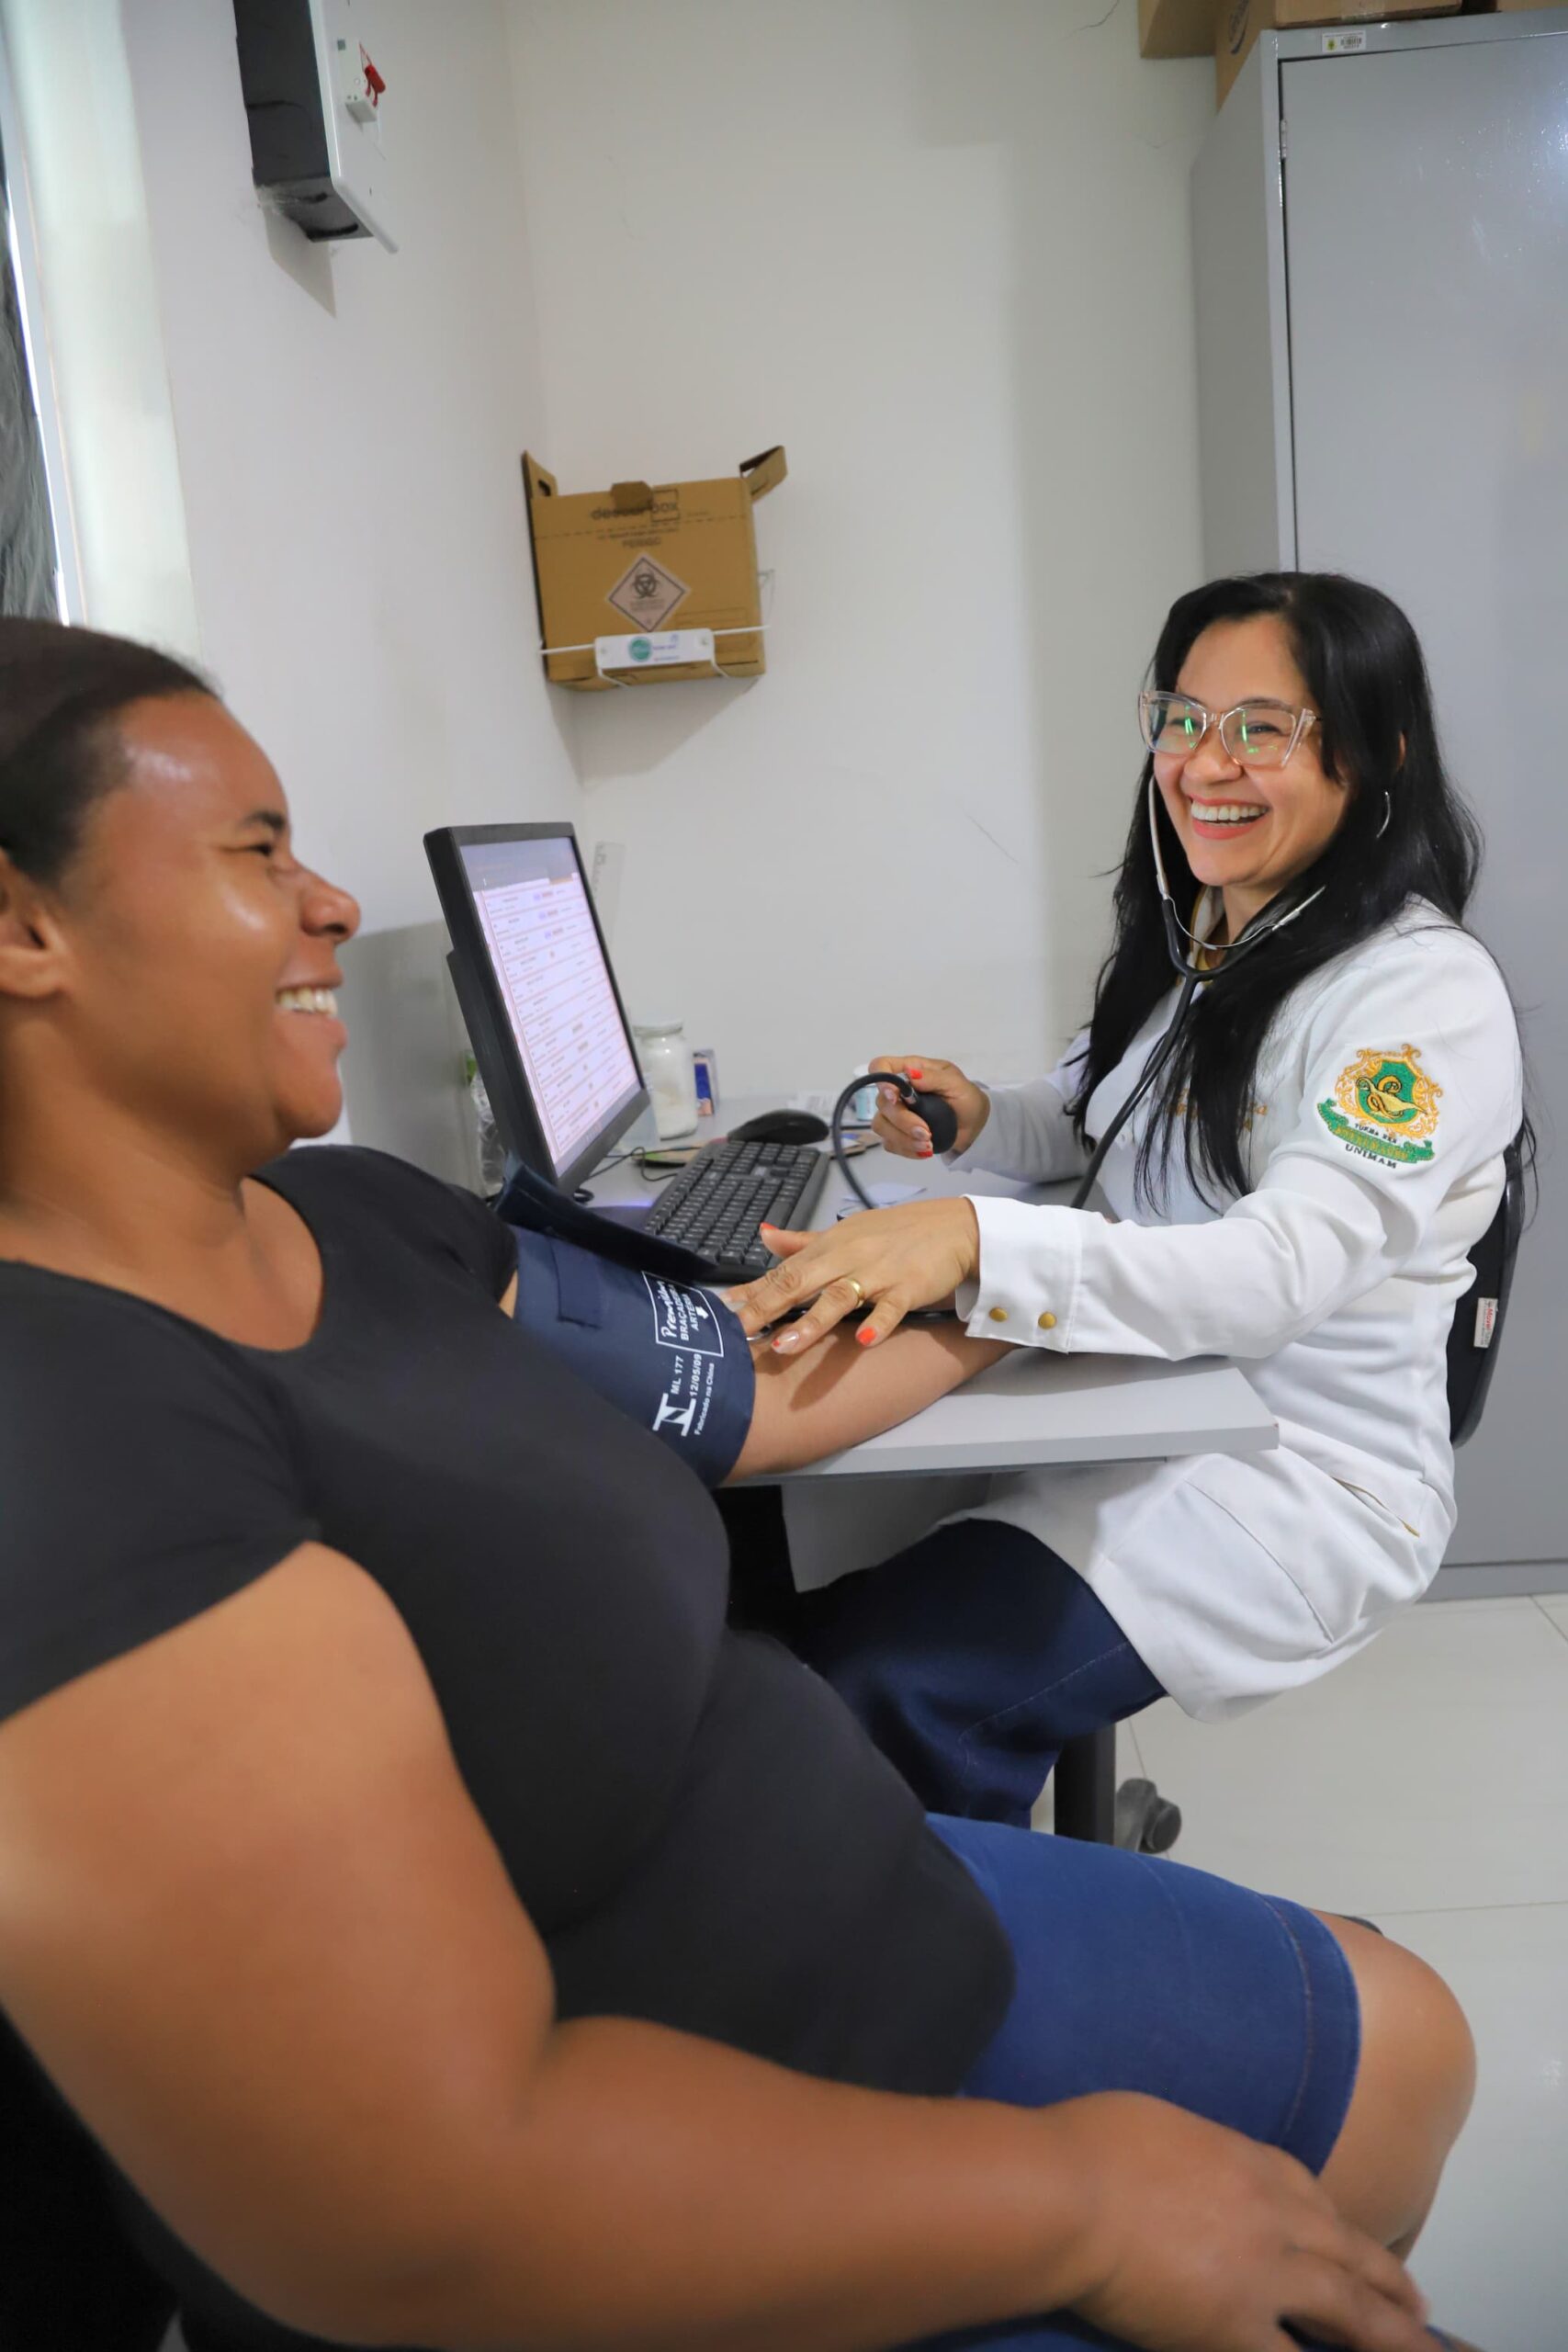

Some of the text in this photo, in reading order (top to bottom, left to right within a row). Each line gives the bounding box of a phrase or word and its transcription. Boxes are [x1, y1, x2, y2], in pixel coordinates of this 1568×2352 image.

[1345, 1143, 1397, 1169] UNIMAM
[671, 1357, 684, 1395] ML 177
[690, 1353, 702, 1396] 12/05/09
[694, 1363, 715, 1436] Fabricado na China
